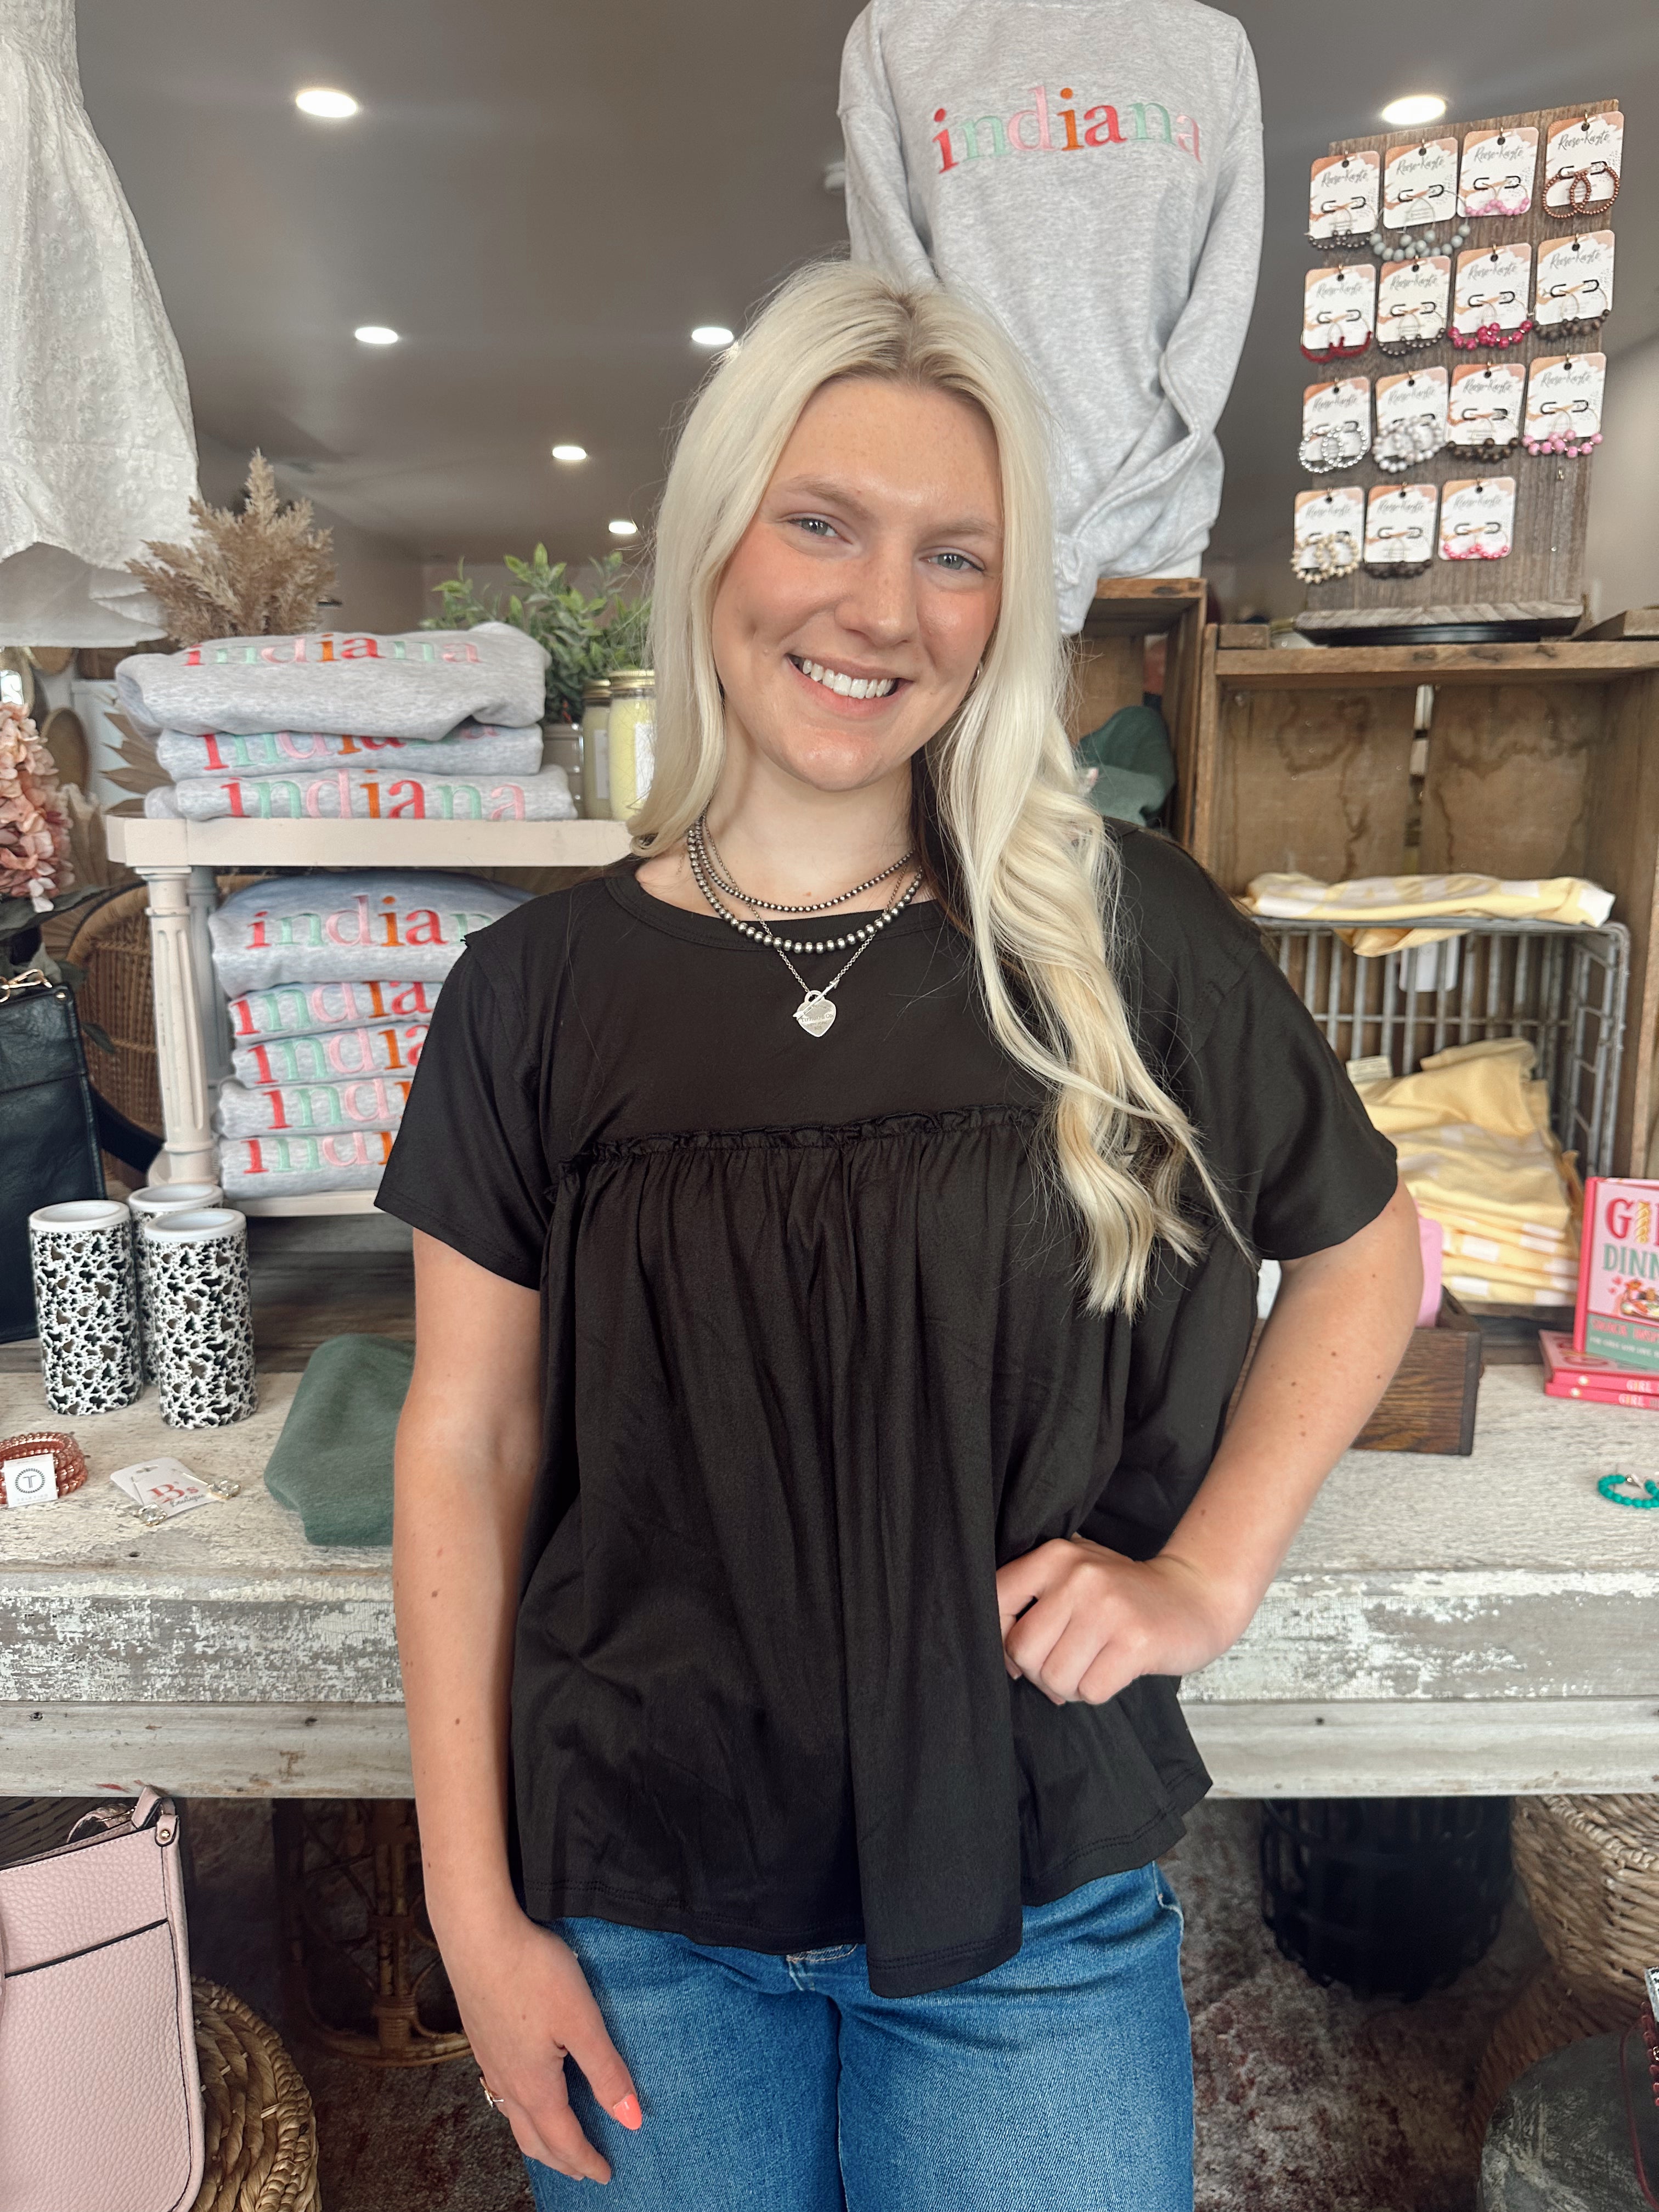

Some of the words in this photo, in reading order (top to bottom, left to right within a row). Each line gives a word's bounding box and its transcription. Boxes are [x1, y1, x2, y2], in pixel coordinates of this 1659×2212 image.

[932, 86, 1203, 174] indiana
[184, 633, 480, 666] indiana
[219, 769, 527, 819] indiana
[1618, 1393, 1644, 1407] GIRL
[1626, 1379, 1651, 1394] GIRL
